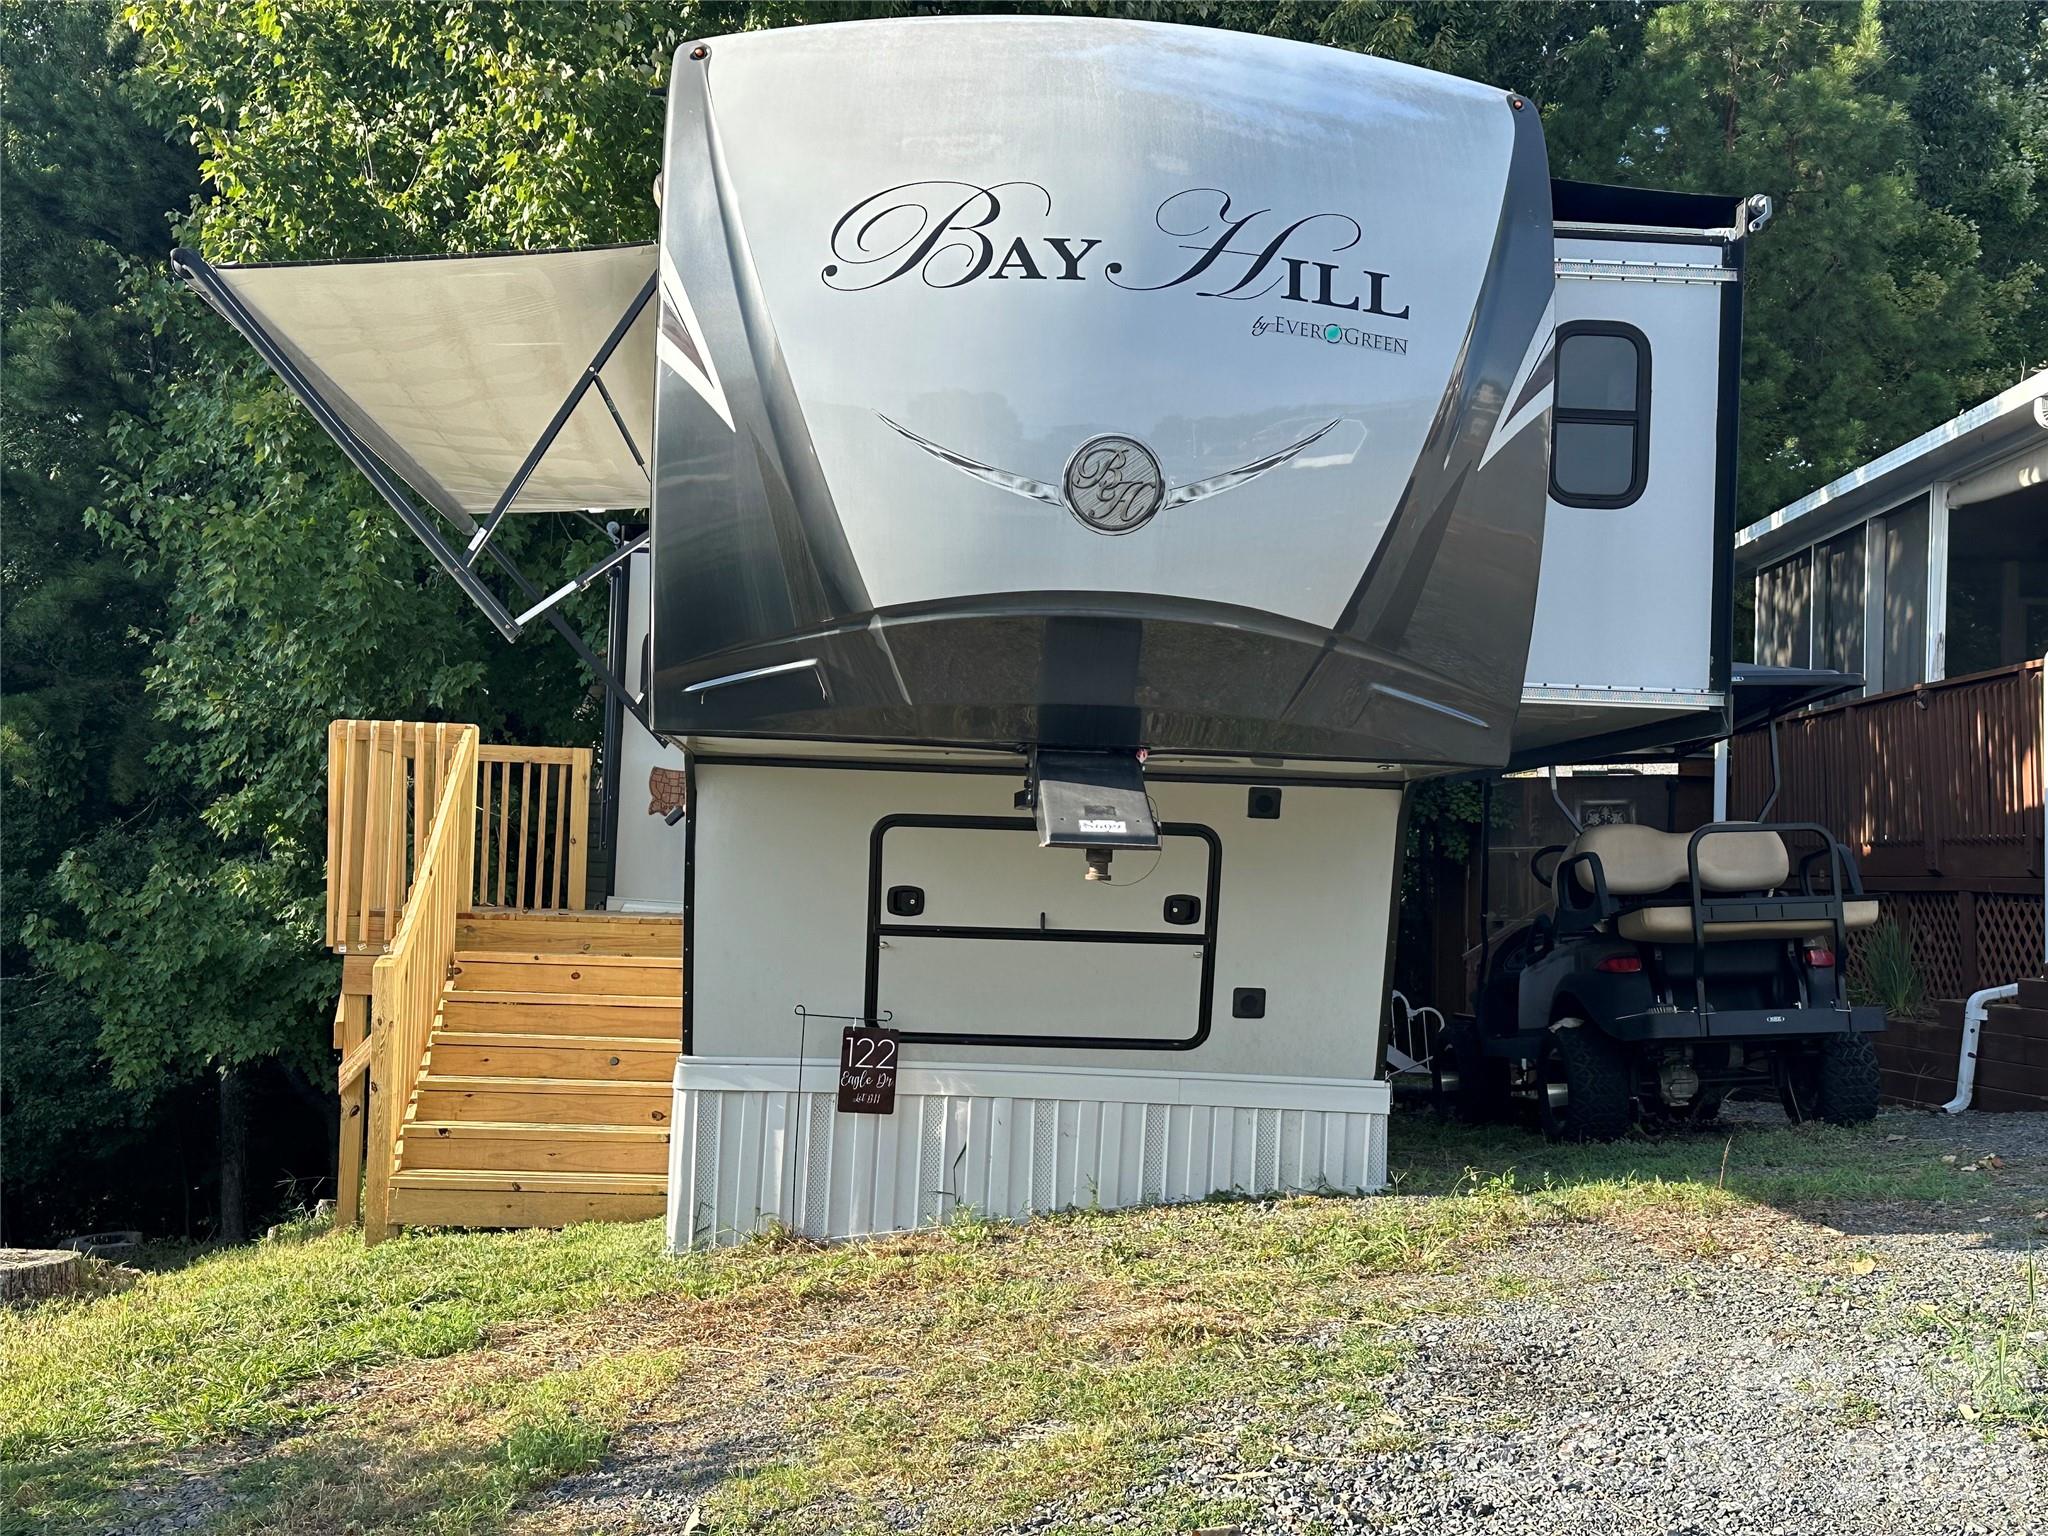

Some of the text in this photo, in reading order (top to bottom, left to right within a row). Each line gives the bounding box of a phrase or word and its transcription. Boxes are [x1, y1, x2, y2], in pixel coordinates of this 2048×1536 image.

[821, 180, 1410, 320] BAY HILL
[1251, 315, 1271, 337] by
[845, 1037, 896, 1069] 122
[840, 1070, 894, 1090] Eagle Dr
